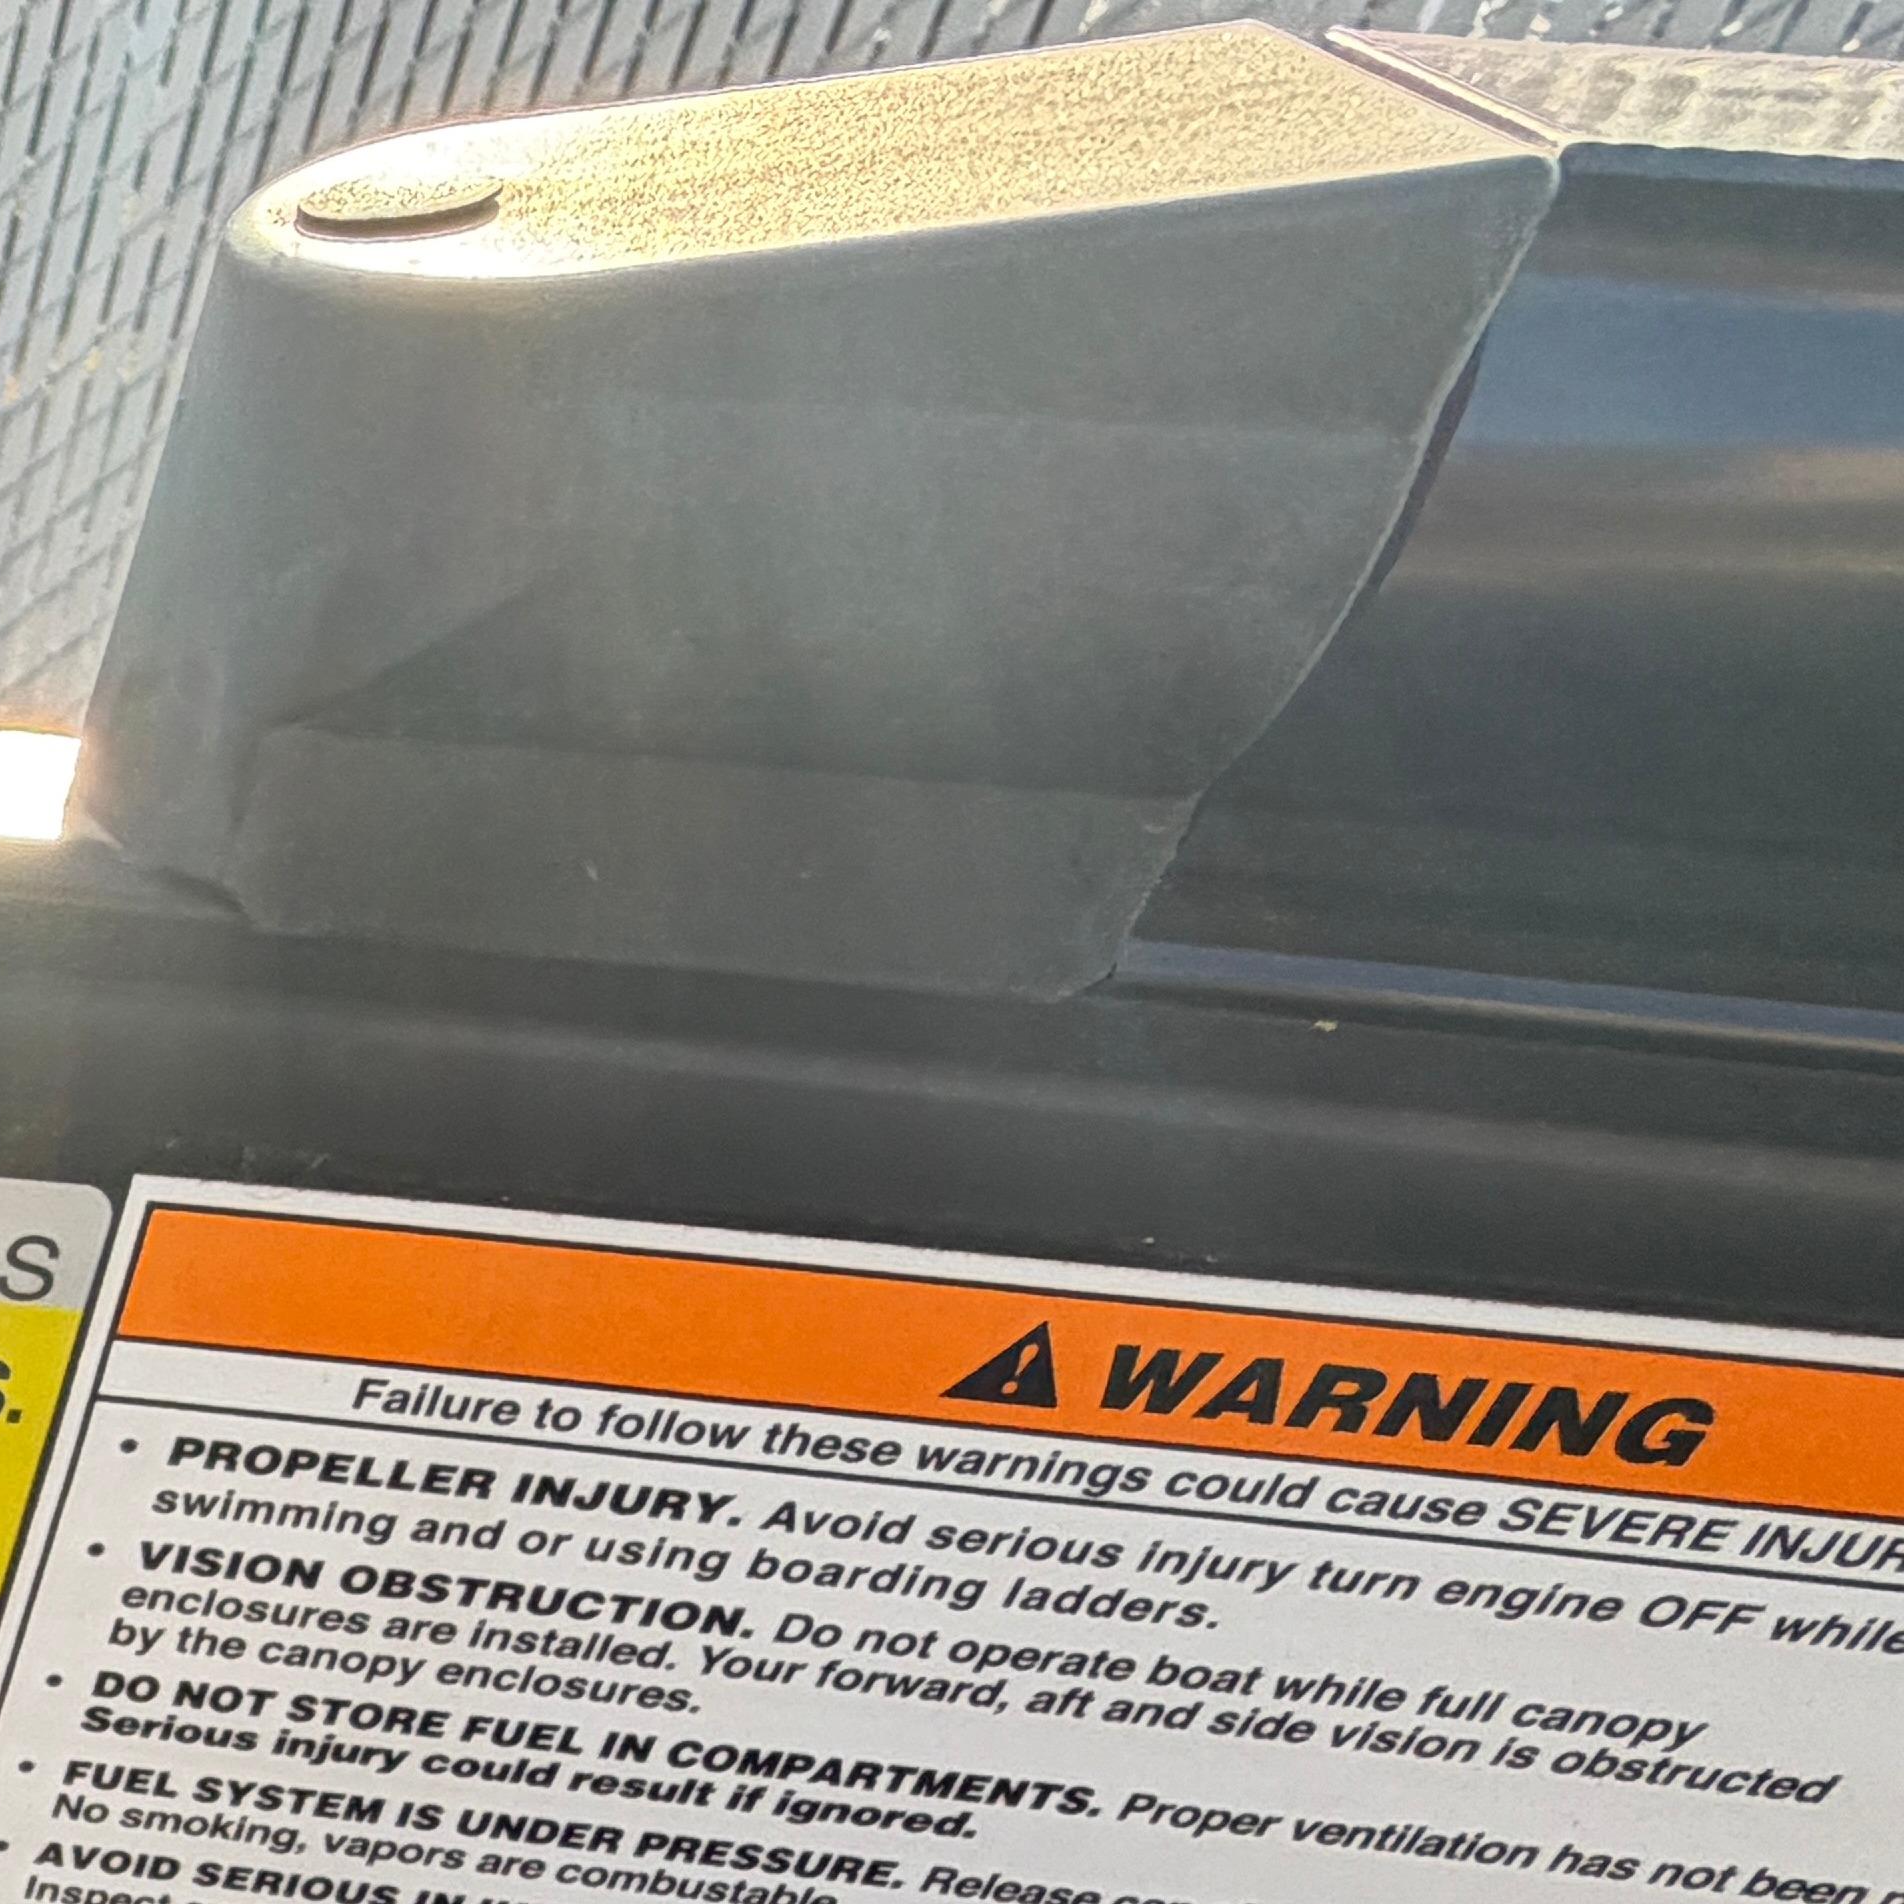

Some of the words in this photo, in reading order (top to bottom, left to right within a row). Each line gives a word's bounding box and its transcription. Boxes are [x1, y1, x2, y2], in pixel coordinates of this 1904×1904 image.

[351, 1377, 522, 1426] Failure
[533, 1397, 583, 1433] to
[595, 1403, 752, 1450] follow
[761, 1422, 903, 1467] these
[916, 1444, 1153, 1498] warnings
[1164, 1471, 1321, 1510] could
[1325, 1487, 1489, 1527] cause
[1497, 1496, 1740, 1553] SEVERE
[1099, 1343, 1716, 1467] WARNING
[140, 1540, 326, 1590] VISION
[339, 1564, 754, 1640] OBSTRUCTION.
[772, 1612, 843, 1649] Do
[853, 1629, 939, 1660] not
[947, 1639, 1137, 1682] operate
[1145, 1654, 1264, 1697] boat
[1272, 1673, 1408, 1713] while
[1416, 1685, 1508, 1723] full
[1511, 1703, 1710, 1749] canopy
[167, 1436, 497, 1500] PROPELLER
[510, 1472, 742, 1527] INJURY.
[758, 1500, 918, 1545] Avoid
[924, 1525, 1125, 1569] serious
[1136, 1540, 1299, 1592] injury
[1308, 1560, 1422, 1600] turn
[1434, 1579, 1625, 1622] engine
[1639, 1594, 1767, 1635] OFF
[1769, 1609, 1904, 1662] while
